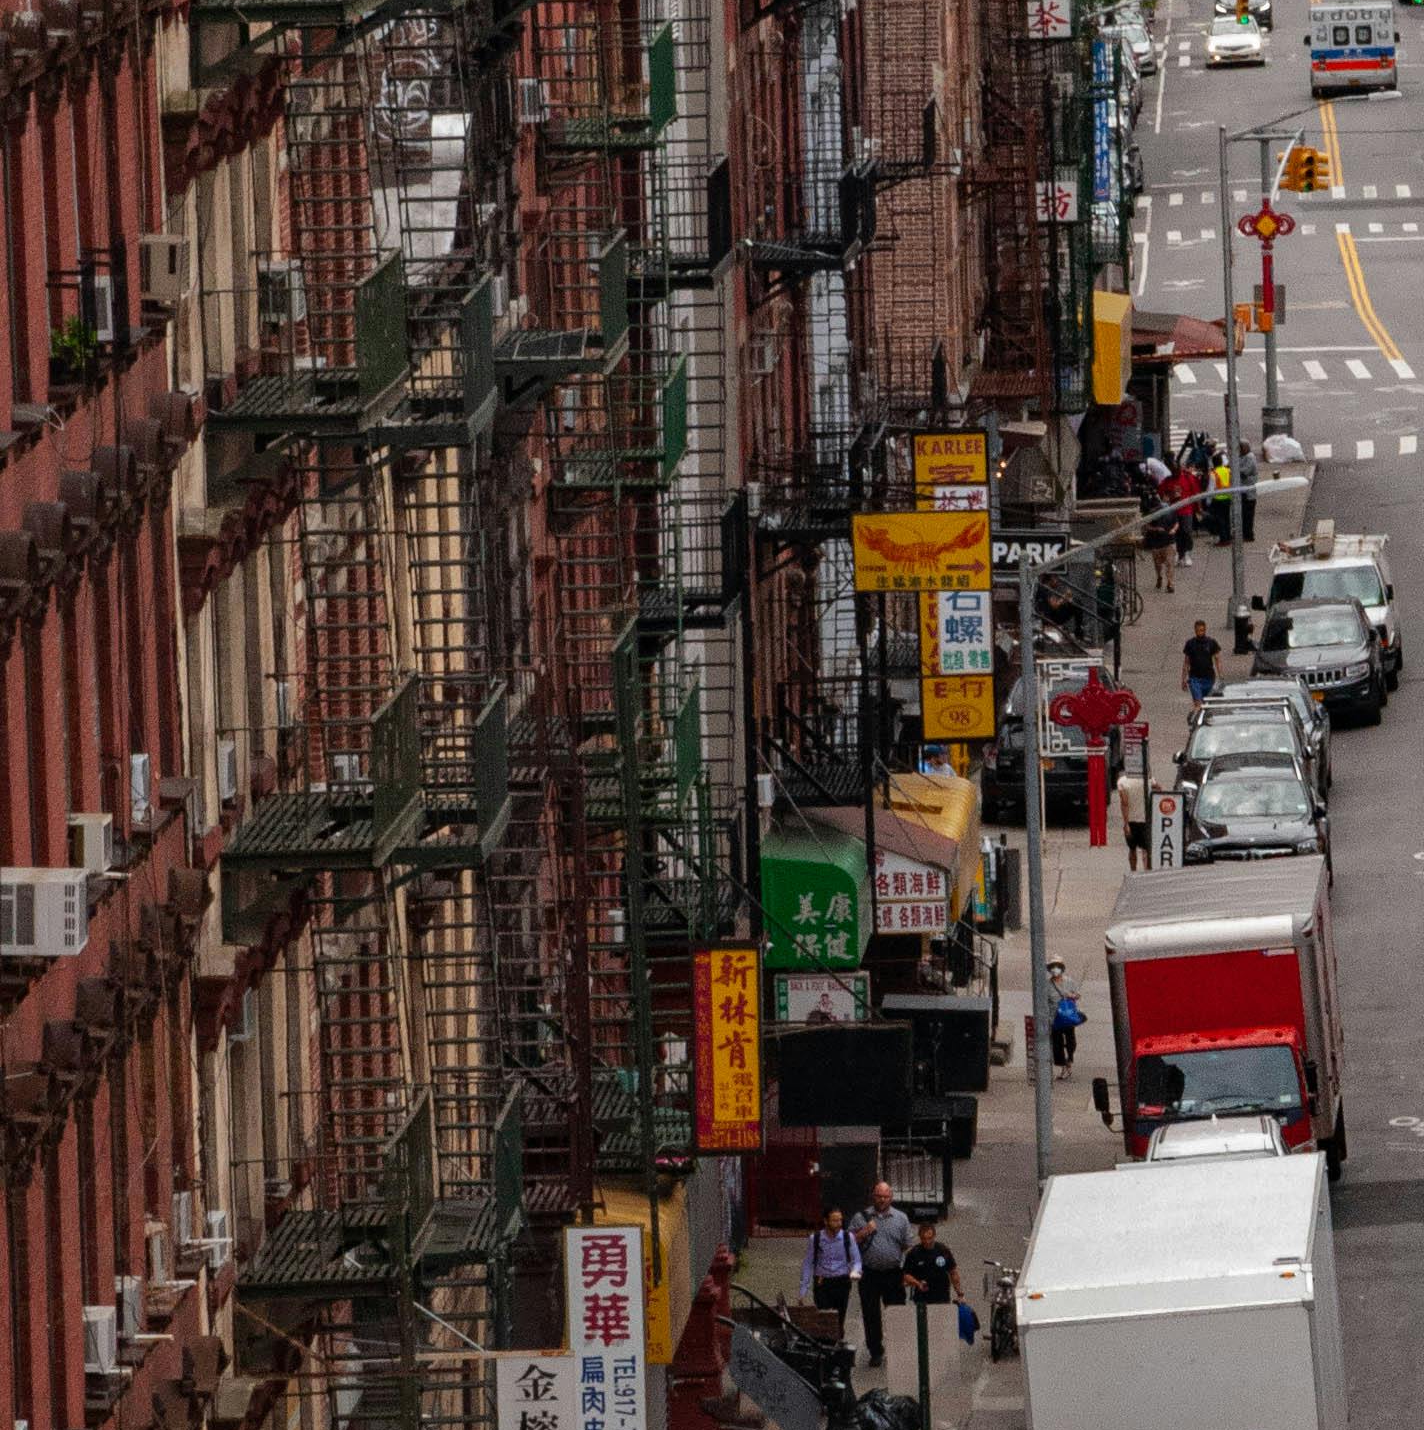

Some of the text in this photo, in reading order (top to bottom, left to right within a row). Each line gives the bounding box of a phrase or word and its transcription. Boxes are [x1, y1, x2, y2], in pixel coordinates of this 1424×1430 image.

[1030, 1, 1069, 36] 茶
[916, 438, 984, 458] KARLEE
[992, 542, 1064, 565] PARK
[713, 953, 757, 1070] 新林肯
[580, 1234, 631, 1348] 勇華
